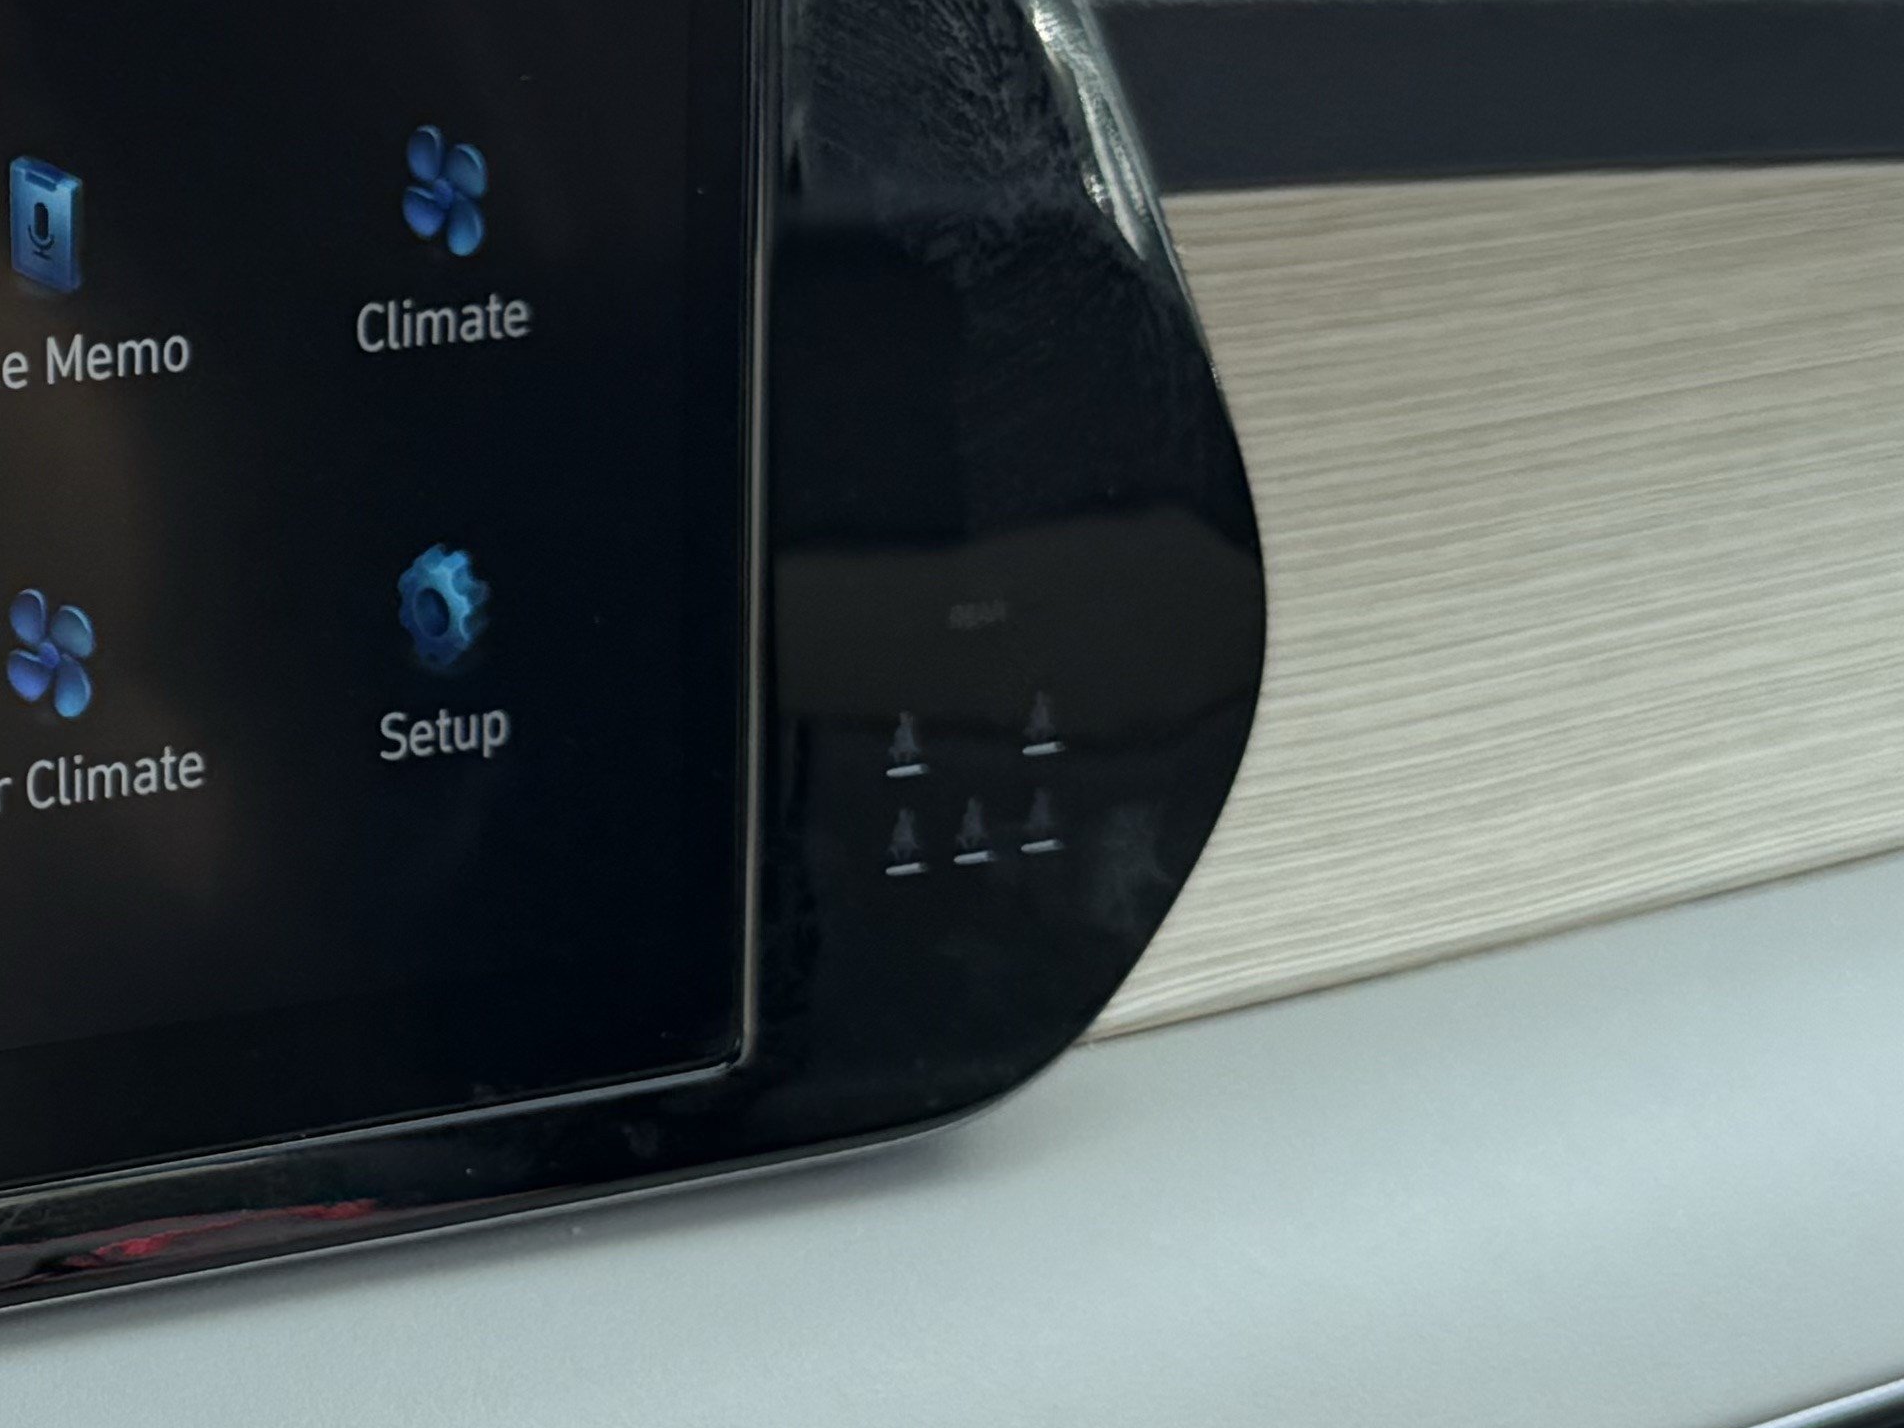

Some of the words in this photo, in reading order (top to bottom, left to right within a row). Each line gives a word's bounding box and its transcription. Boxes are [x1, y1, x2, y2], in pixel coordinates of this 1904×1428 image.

[356, 293, 530, 353] Climate
[46, 333, 190, 385] Memo
[379, 708, 510, 761] Setup
[26, 745, 205, 810] Climate
